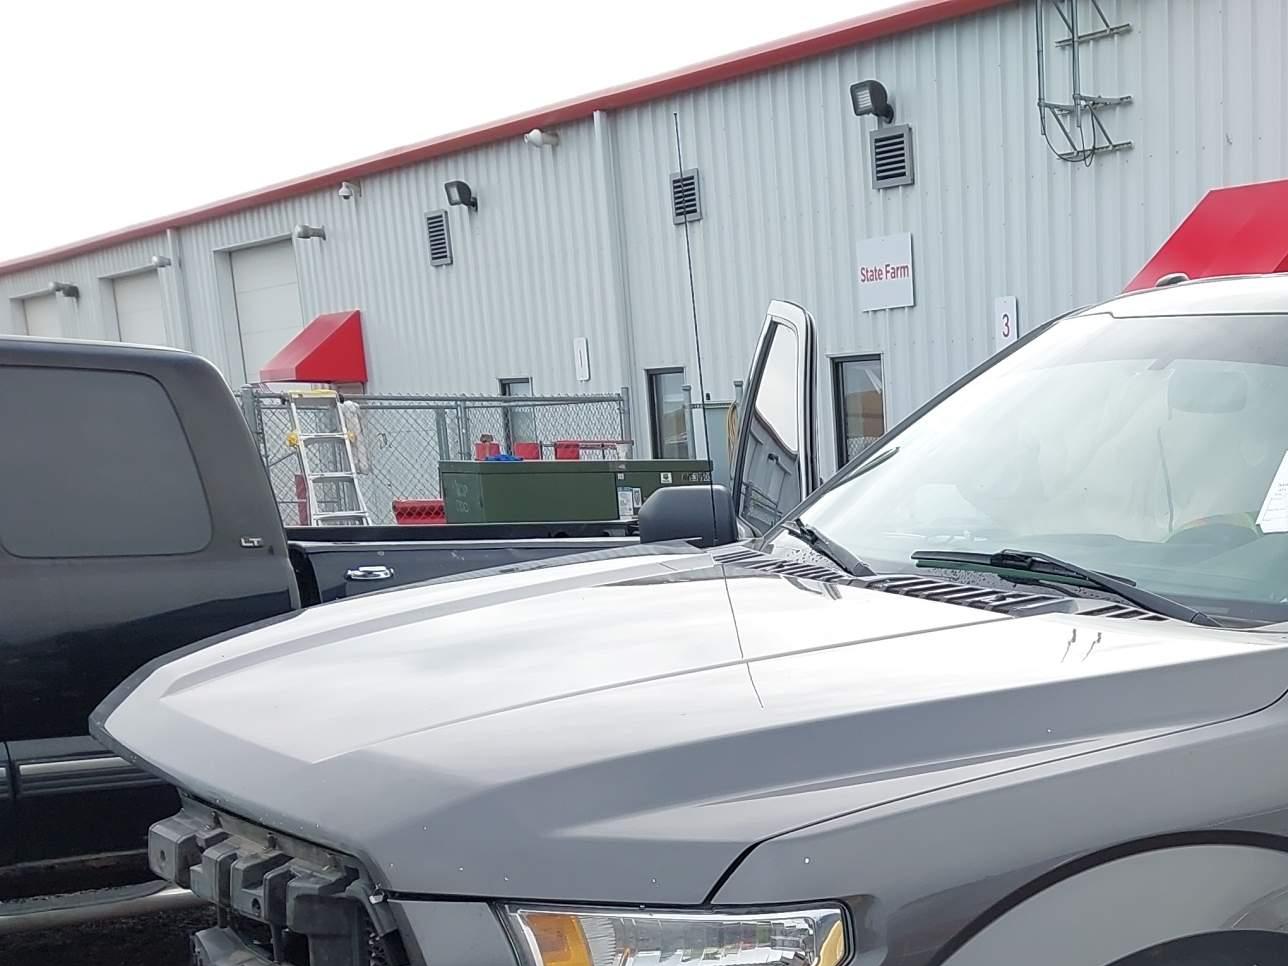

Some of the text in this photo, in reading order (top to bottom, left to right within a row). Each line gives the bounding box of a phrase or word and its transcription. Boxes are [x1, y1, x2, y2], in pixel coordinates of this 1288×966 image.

[860, 263, 909, 283] State Farm
[1002, 313, 1010, 338] 3
